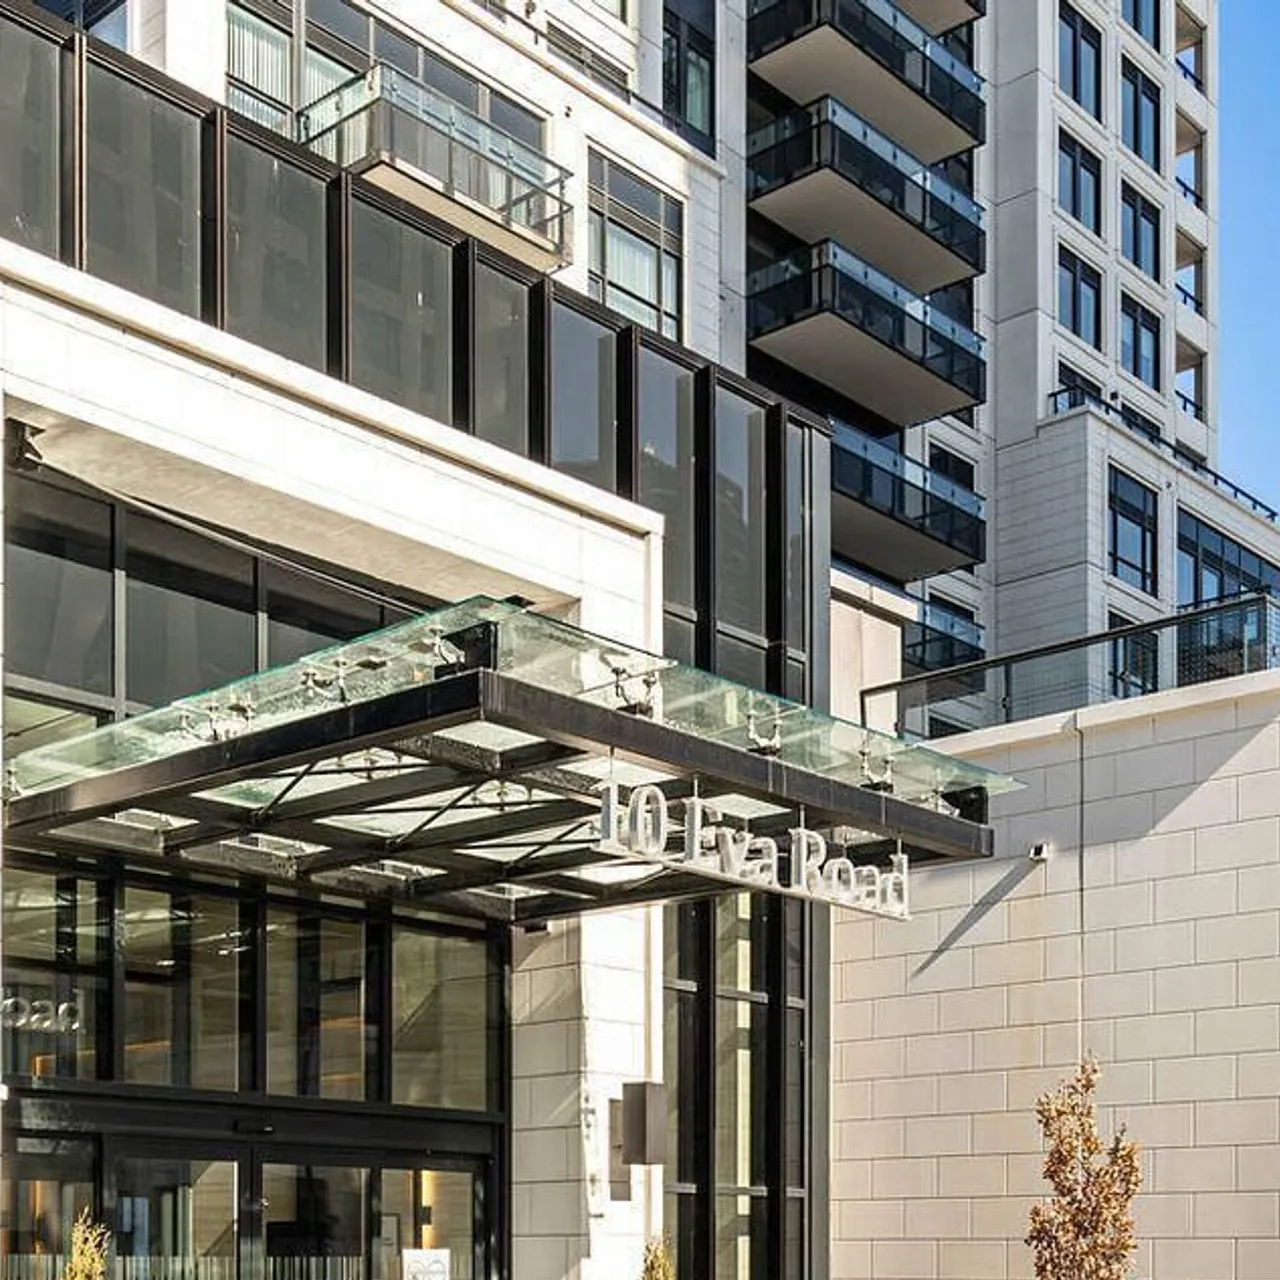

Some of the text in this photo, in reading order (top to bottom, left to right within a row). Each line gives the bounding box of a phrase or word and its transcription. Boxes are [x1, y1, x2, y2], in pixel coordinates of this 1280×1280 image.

[592, 783, 910, 919] 10 Eva Road
